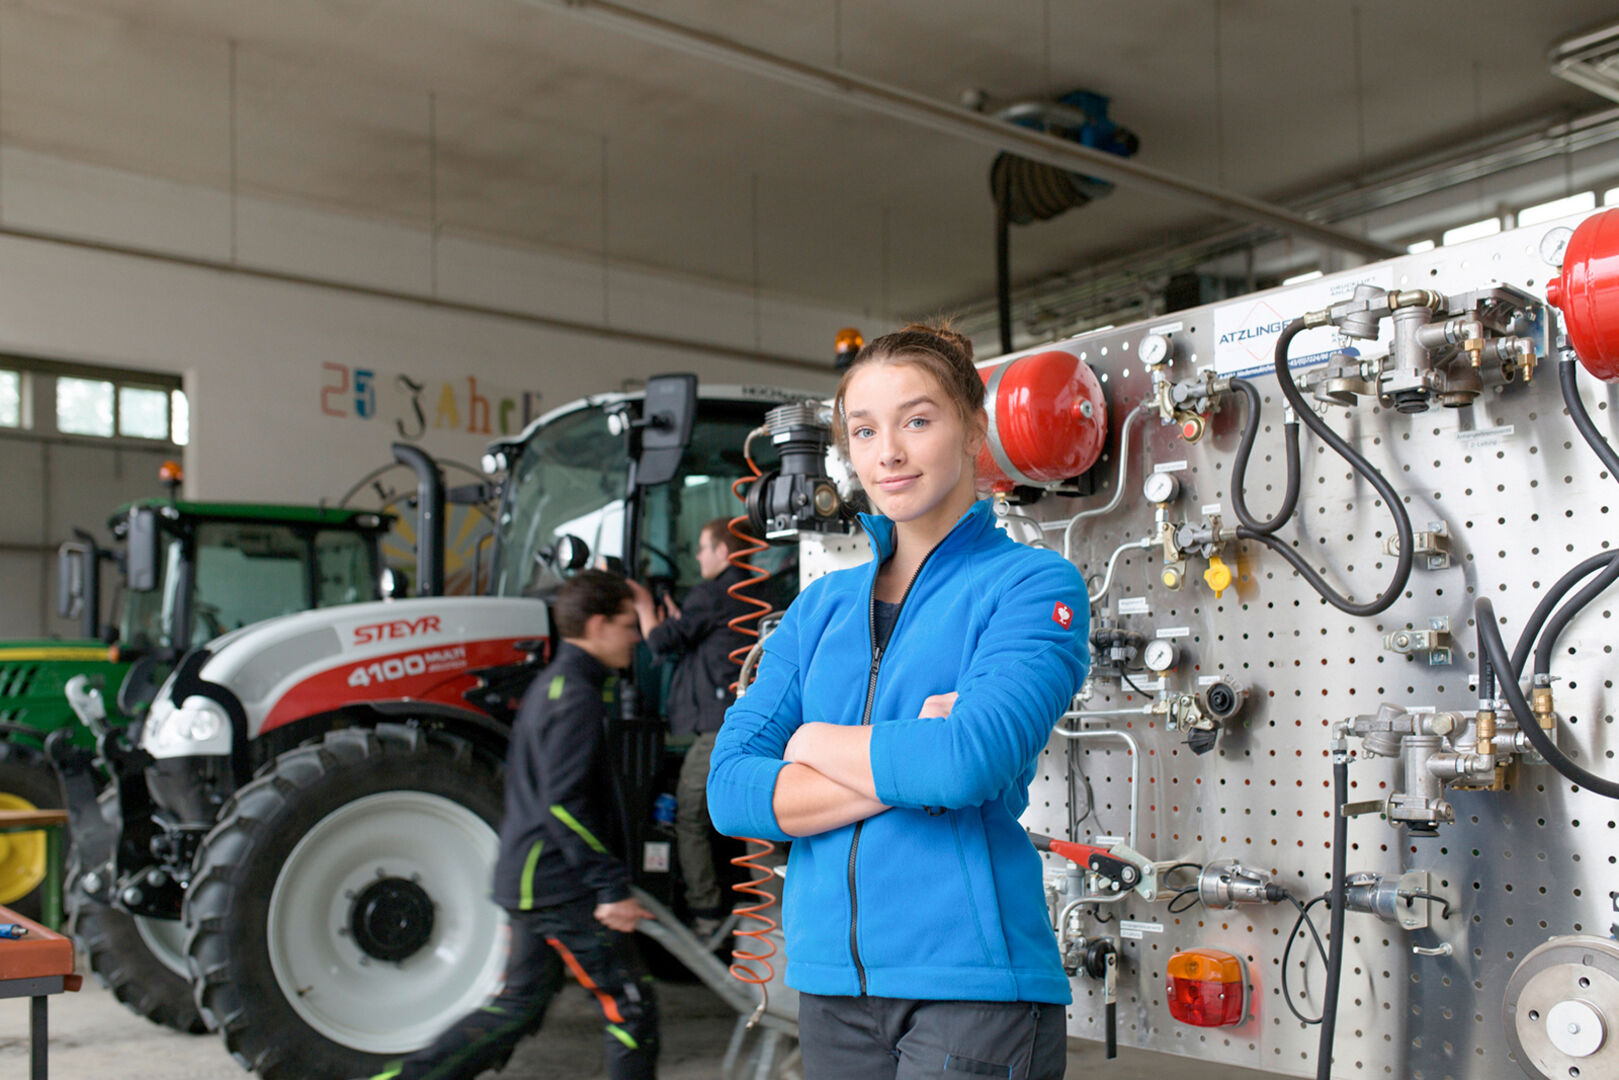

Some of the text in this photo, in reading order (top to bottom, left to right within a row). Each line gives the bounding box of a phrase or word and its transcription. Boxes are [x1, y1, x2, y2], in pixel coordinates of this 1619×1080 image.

[1218, 317, 1297, 345] ATZLINGE
[320, 361, 376, 420] 25
[353, 614, 442, 646] STEYR
[347, 653, 426, 688] 4100
